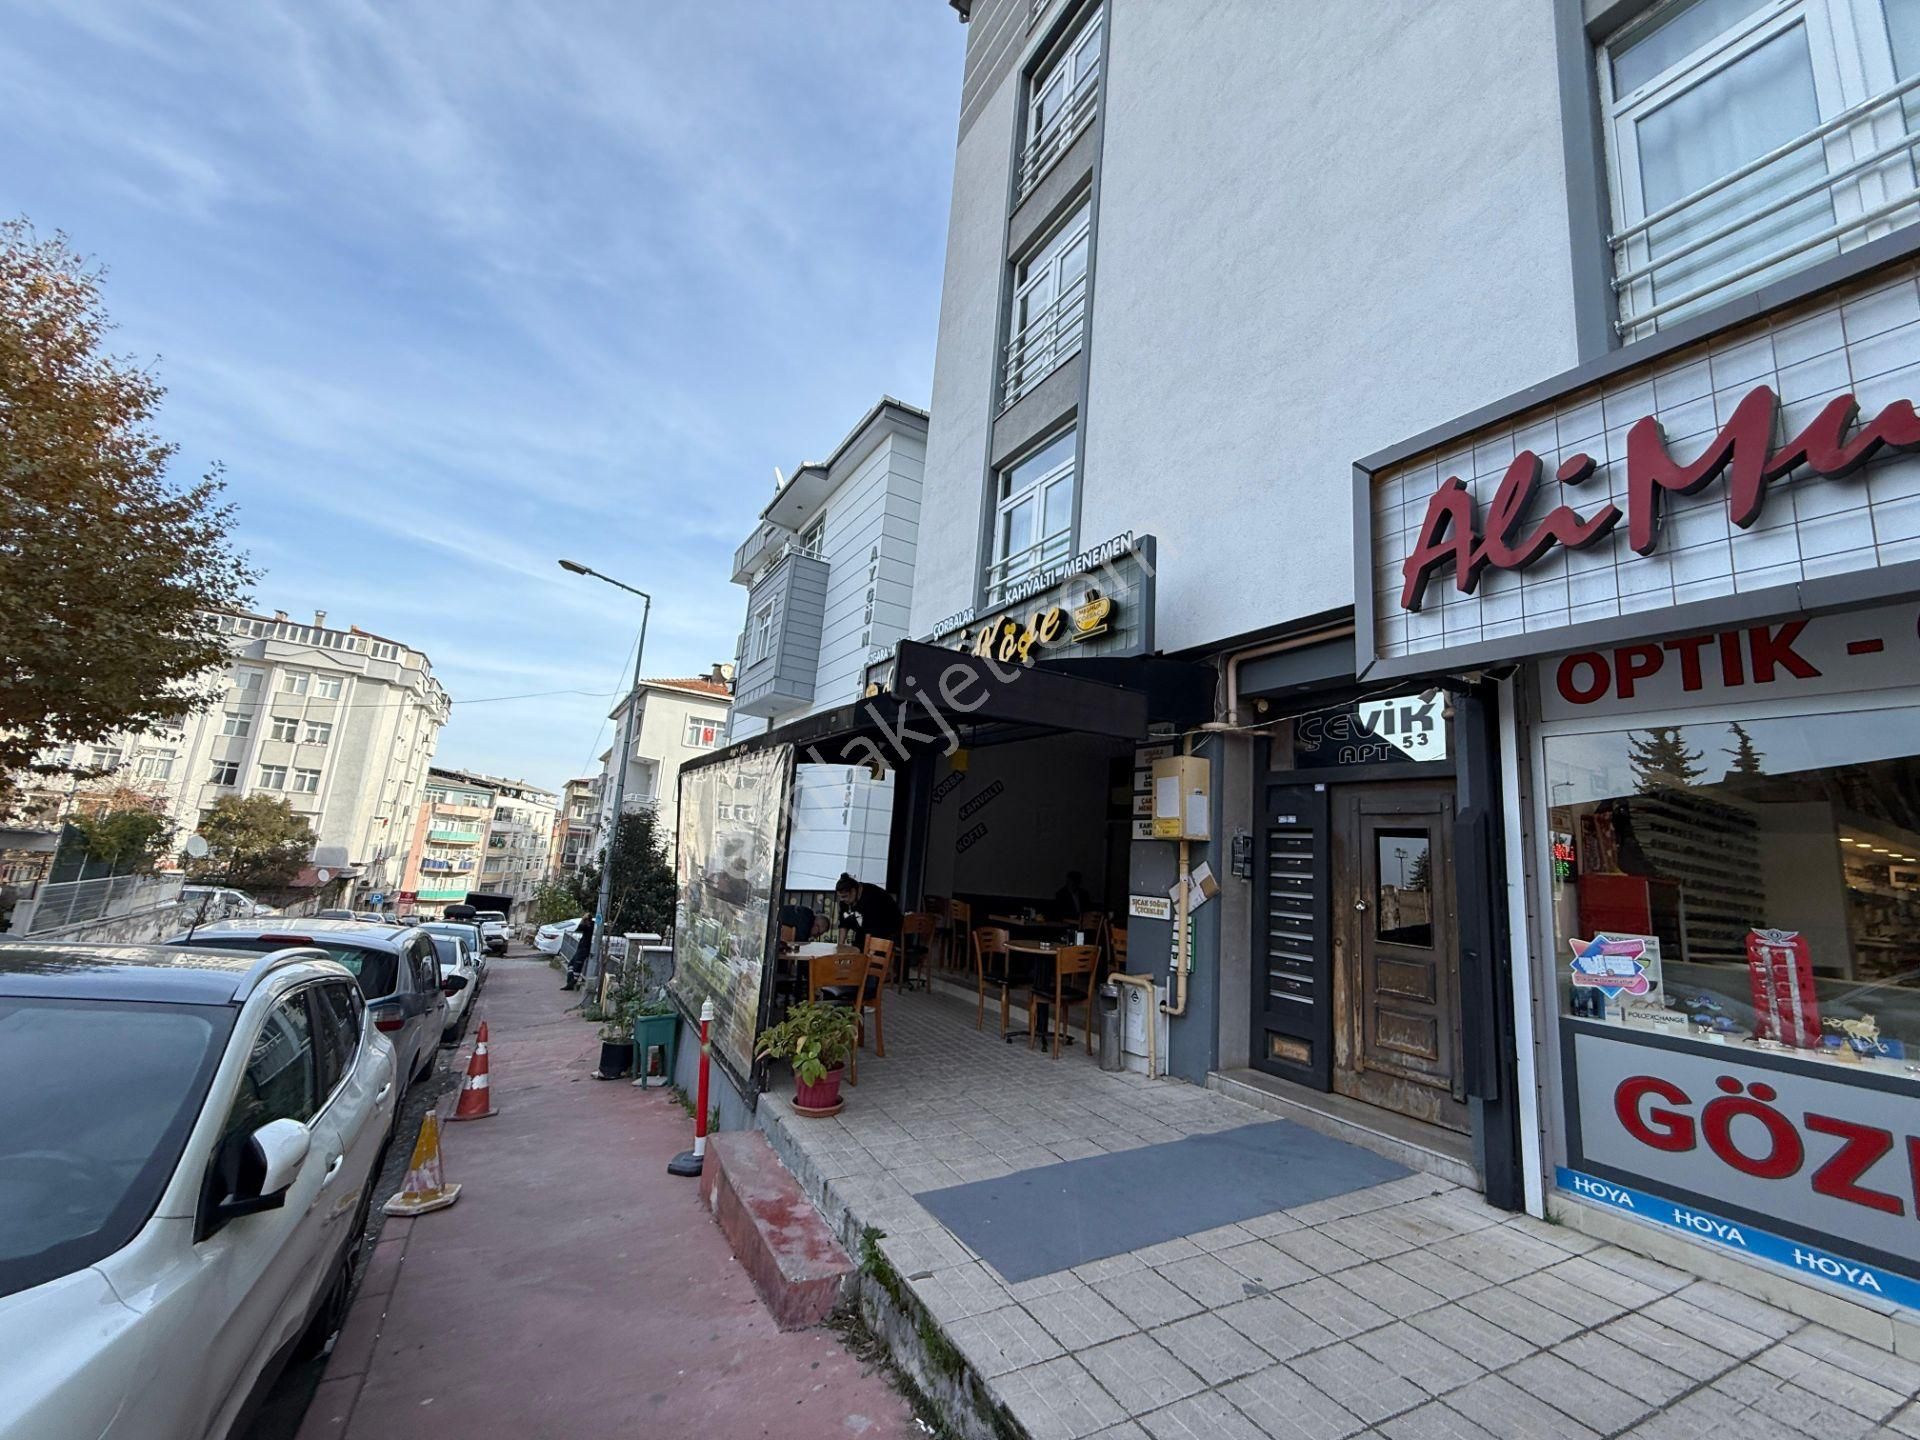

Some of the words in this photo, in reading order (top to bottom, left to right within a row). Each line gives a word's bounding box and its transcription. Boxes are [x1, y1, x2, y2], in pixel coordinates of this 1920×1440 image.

[1063, 530, 1133, 579] MENEMEN
[1005, 569, 1056, 606] KAHVALTI
[933, 607, 976, 641] ÇORBALAR
[1339, 743, 1393, 763] APT
[1402, 733, 1429, 749] 53
[1614, 1075, 1920, 1221] GÖZ
[1573, 1176, 1634, 1208] HOYA
[1671, 1208, 1746, 1246] HOYA
[1791, 1248, 1882, 1292] HOYA
